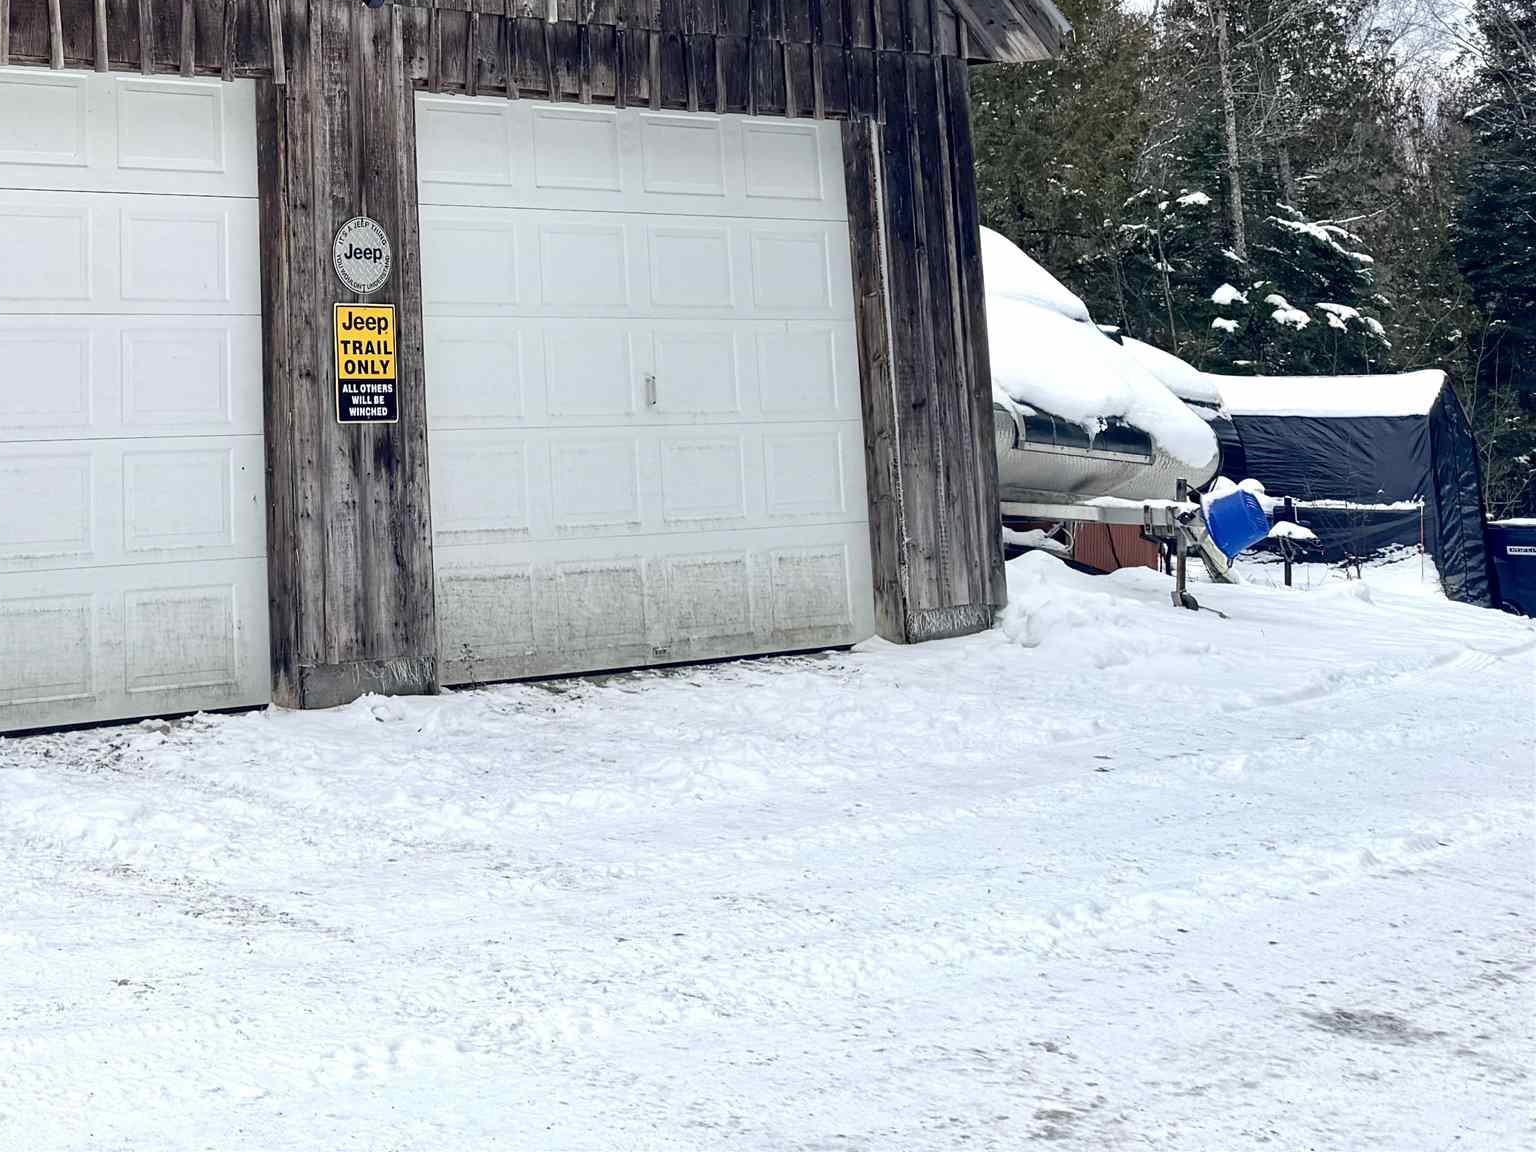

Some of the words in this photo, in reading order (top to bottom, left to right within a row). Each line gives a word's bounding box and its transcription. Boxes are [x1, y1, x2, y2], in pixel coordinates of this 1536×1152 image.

[354, 220, 369, 228] JEEP
[371, 224, 386, 245] THING
[344, 243, 382, 263] Jeep
[342, 311, 389, 335] Jeep
[341, 340, 393, 355] TRAIL
[344, 359, 390, 375] ONLY
[342, 383, 359, 393] ALL
[360, 383, 393, 393] OTHERS
[351, 395, 373, 405] WILL
[373, 395, 385, 405] BE
[349, 407, 388, 417] WINCHED
